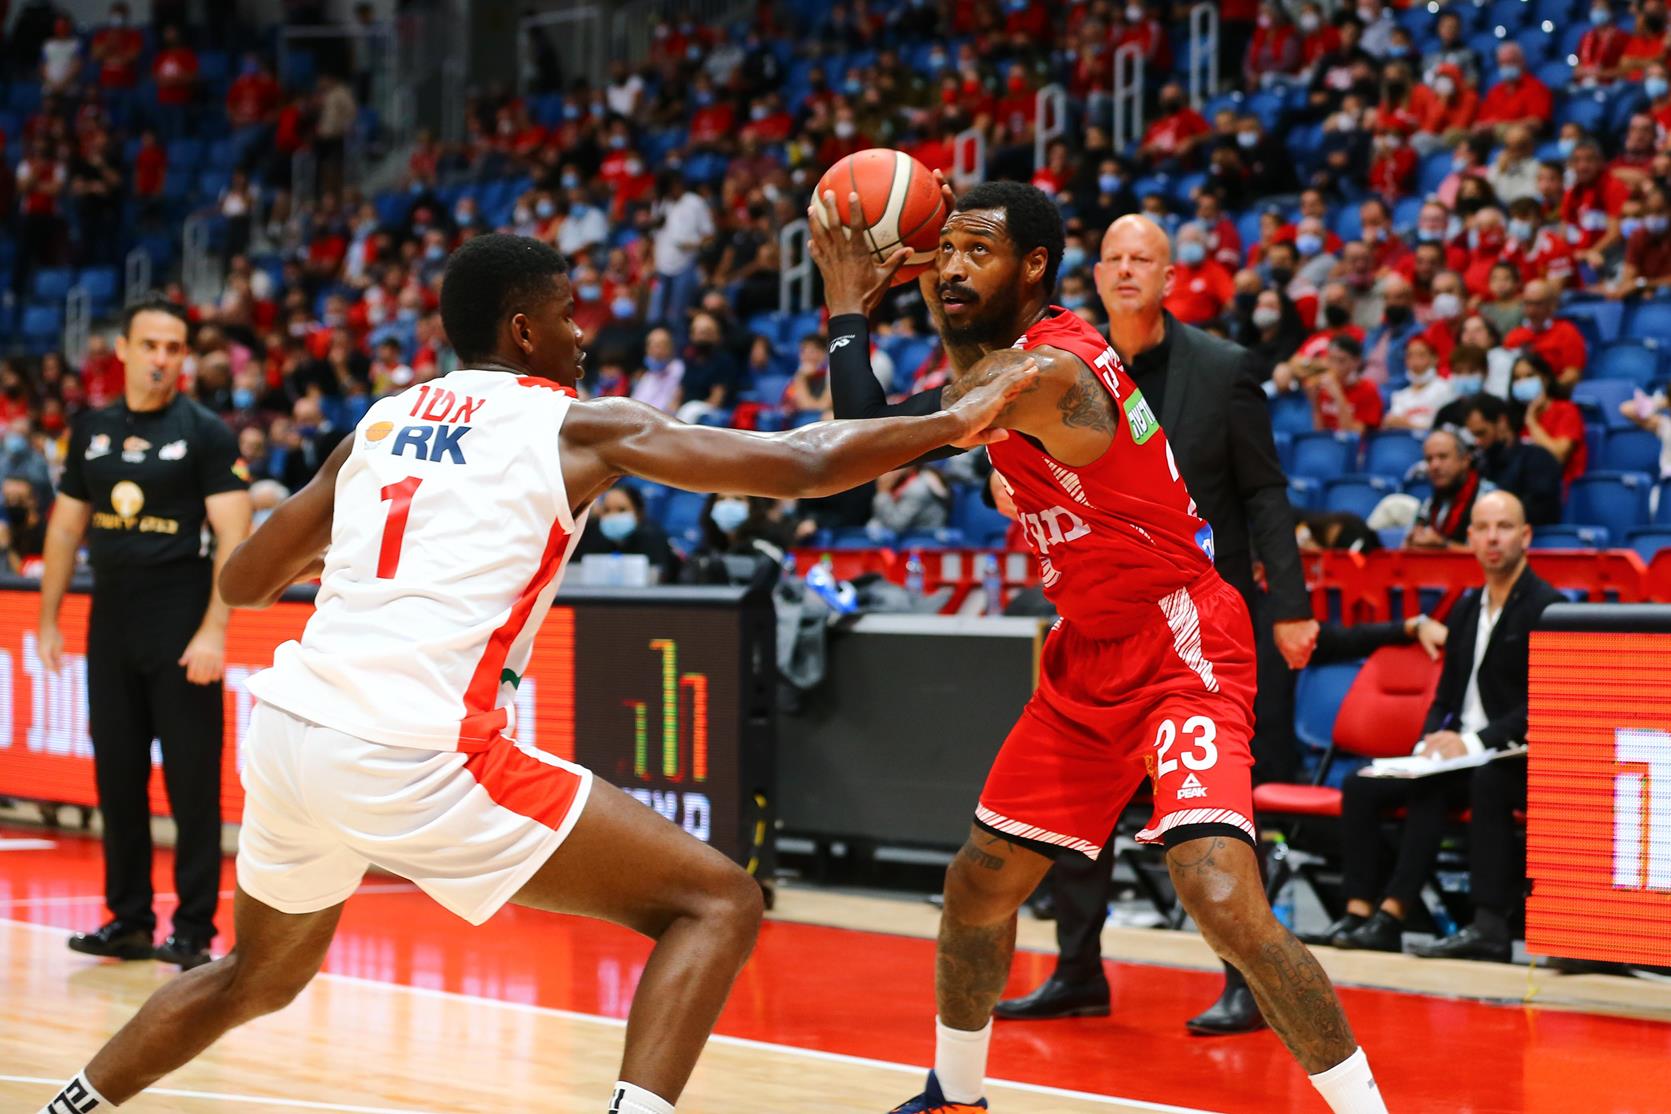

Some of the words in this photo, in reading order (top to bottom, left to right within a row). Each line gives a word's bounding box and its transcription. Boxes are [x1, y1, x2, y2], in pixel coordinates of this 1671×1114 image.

[376, 475, 423, 579] 1
[1153, 715, 1218, 779] 23
[1177, 786, 1208, 800] PEAK
